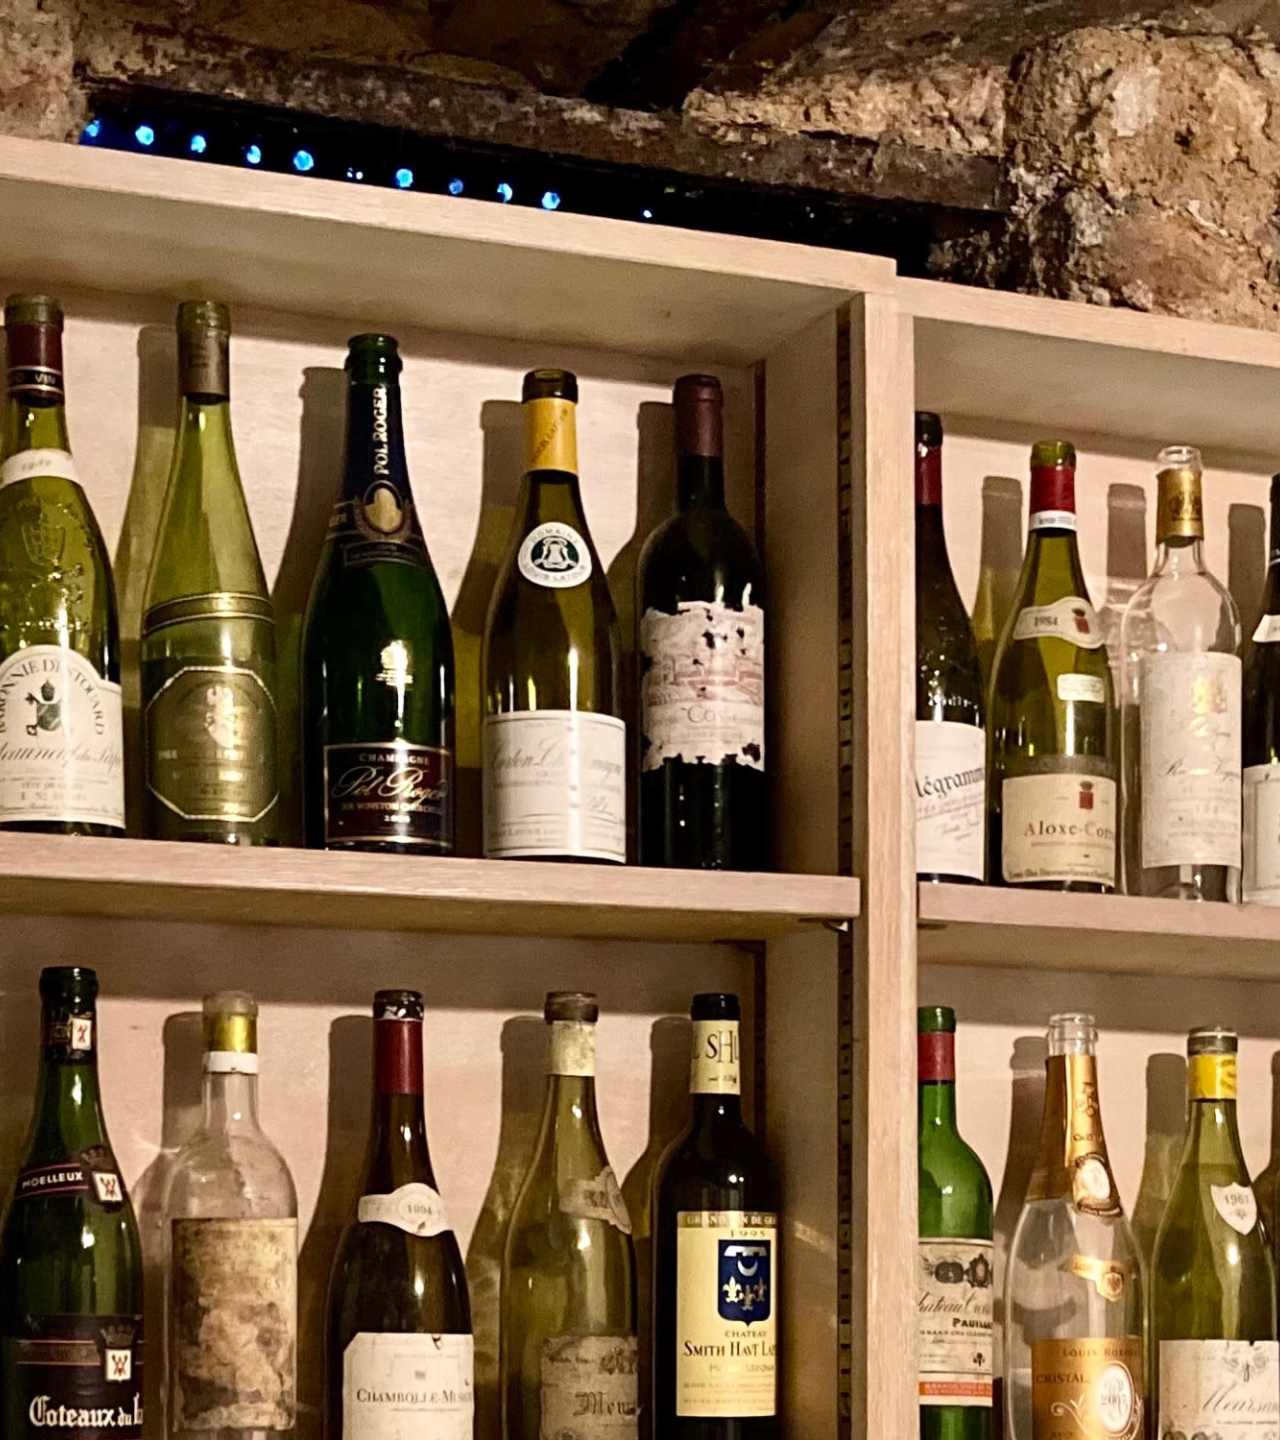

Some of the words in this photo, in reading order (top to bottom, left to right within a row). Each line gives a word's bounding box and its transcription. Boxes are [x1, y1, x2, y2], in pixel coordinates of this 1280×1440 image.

[373, 386, 389, 437] ROGER
[374, 438, 389, 475] POL
[377, 767, 447, 810] Roger
[23, 1171, 83, 1188] MOELLEUX
[683, 1340, 726, 1357] SMITH
[29, 1394, 116, 1428] Coteaux
[118, 1410, 132, 1427] du
